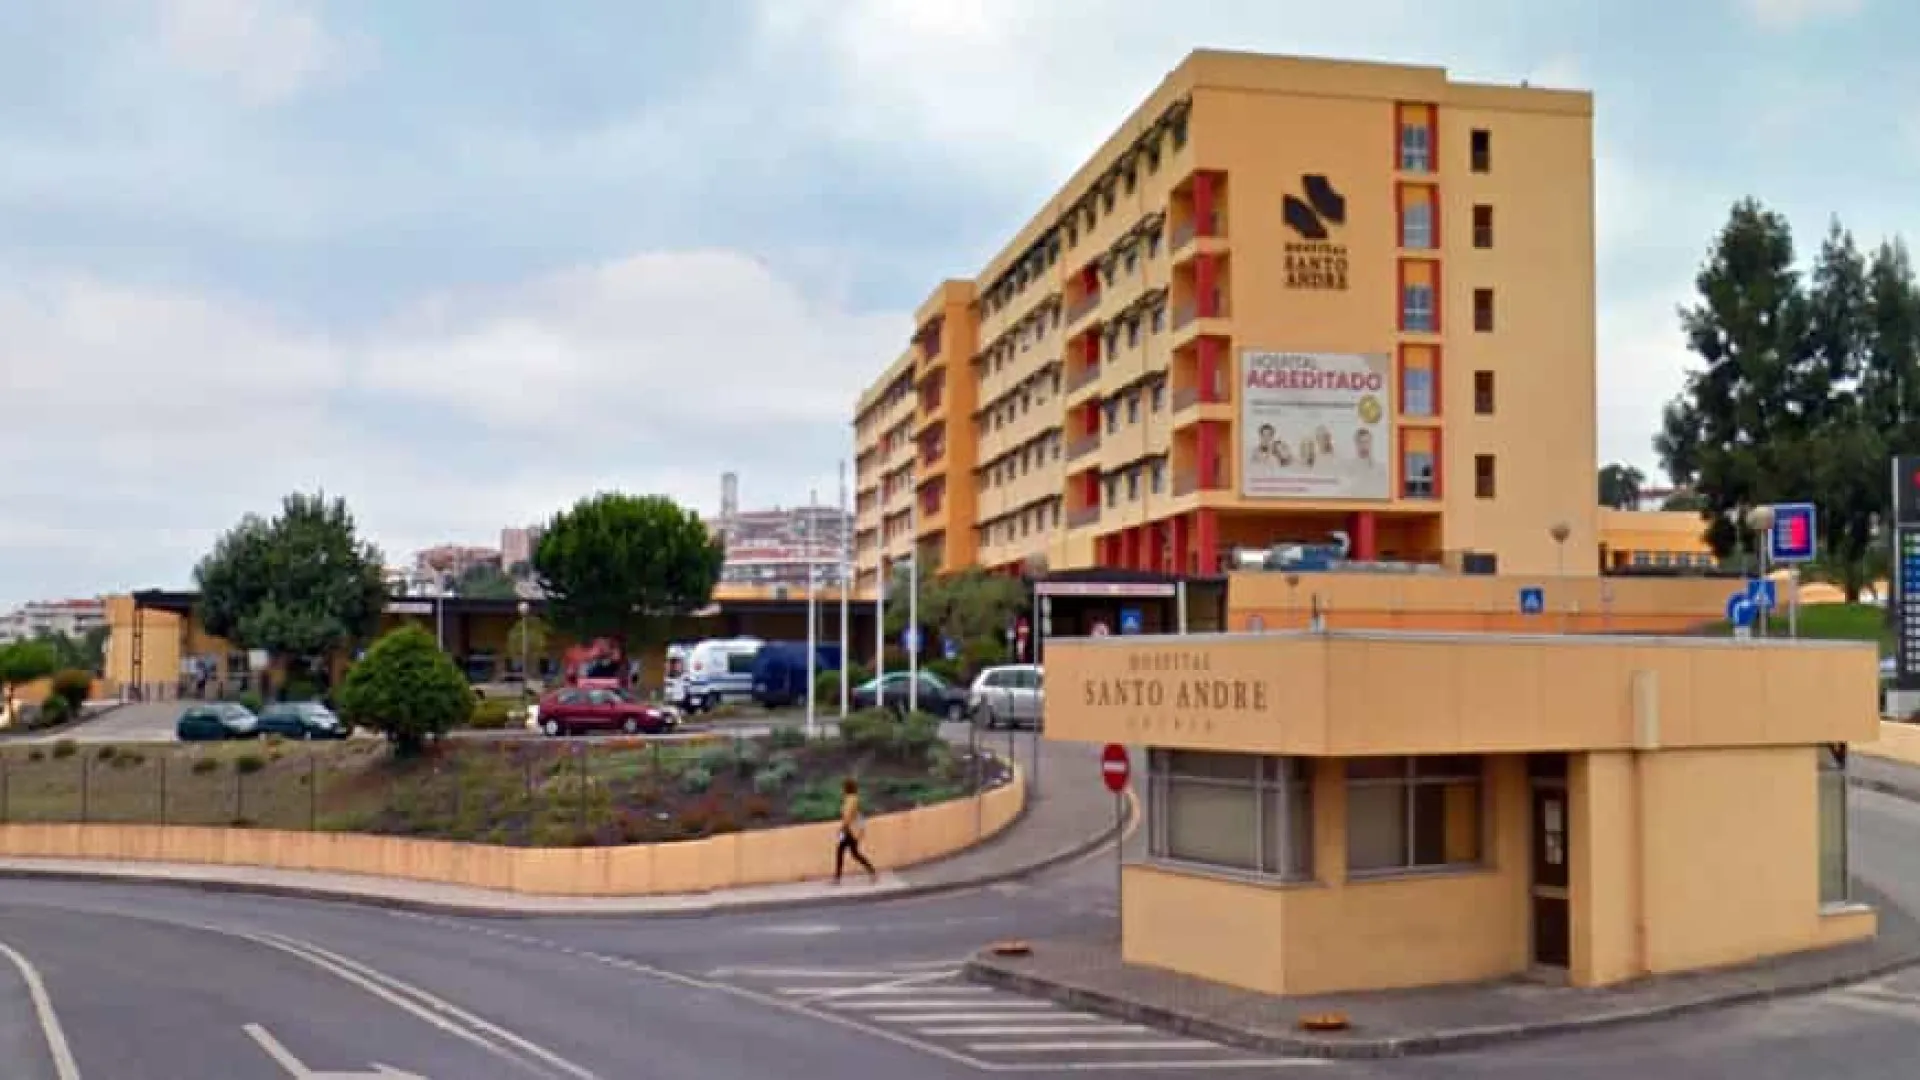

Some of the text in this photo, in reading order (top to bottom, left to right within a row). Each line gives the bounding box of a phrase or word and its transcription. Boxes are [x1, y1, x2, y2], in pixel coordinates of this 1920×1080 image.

[1284, 255, 1348, 271] SANTO
[1247, 369, 1382, 390] ACREDITADO
[1085, 679, 1268, 711] SANTO ANDRE
